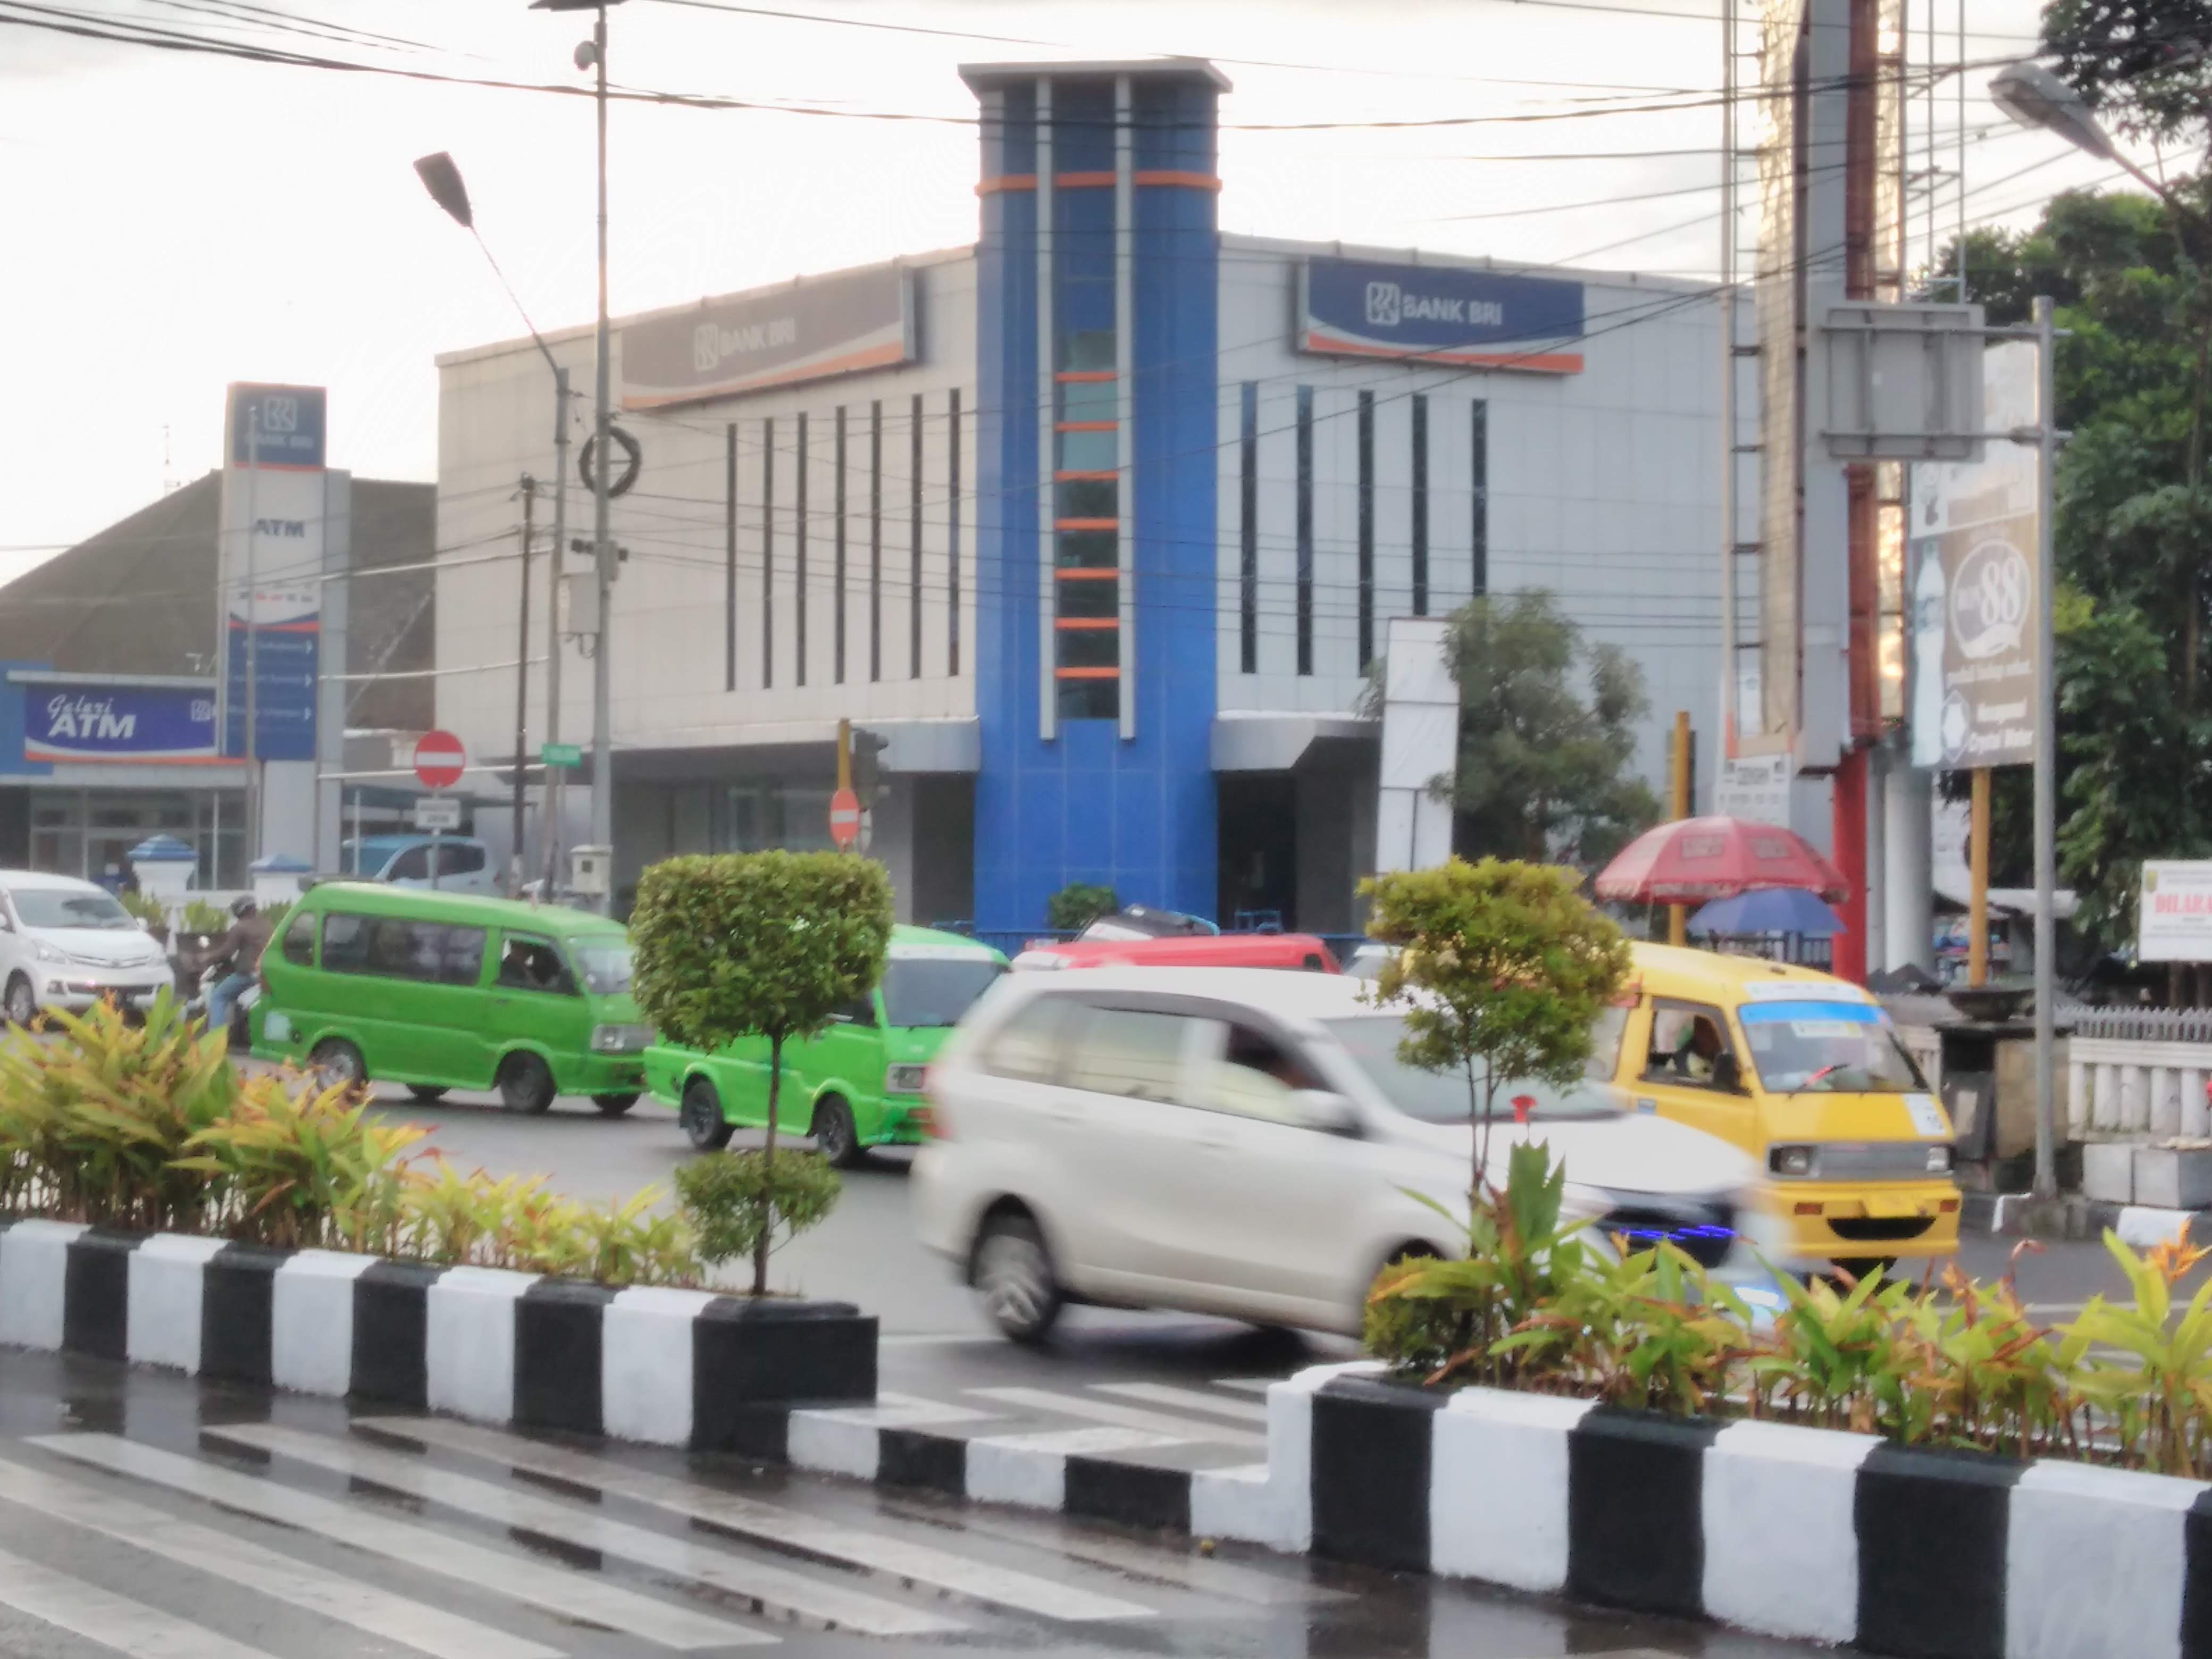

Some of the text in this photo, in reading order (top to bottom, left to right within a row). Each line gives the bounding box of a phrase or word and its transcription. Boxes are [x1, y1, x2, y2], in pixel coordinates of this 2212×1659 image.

[1403, 295, 1502, 325] BANK BRI
[719, 317, 795, 356] BANK BRI
[255, 518, 305, 538] ATM
[1980, 557, 2021, 626] 88
[47, 713, 137, 739] ATM
